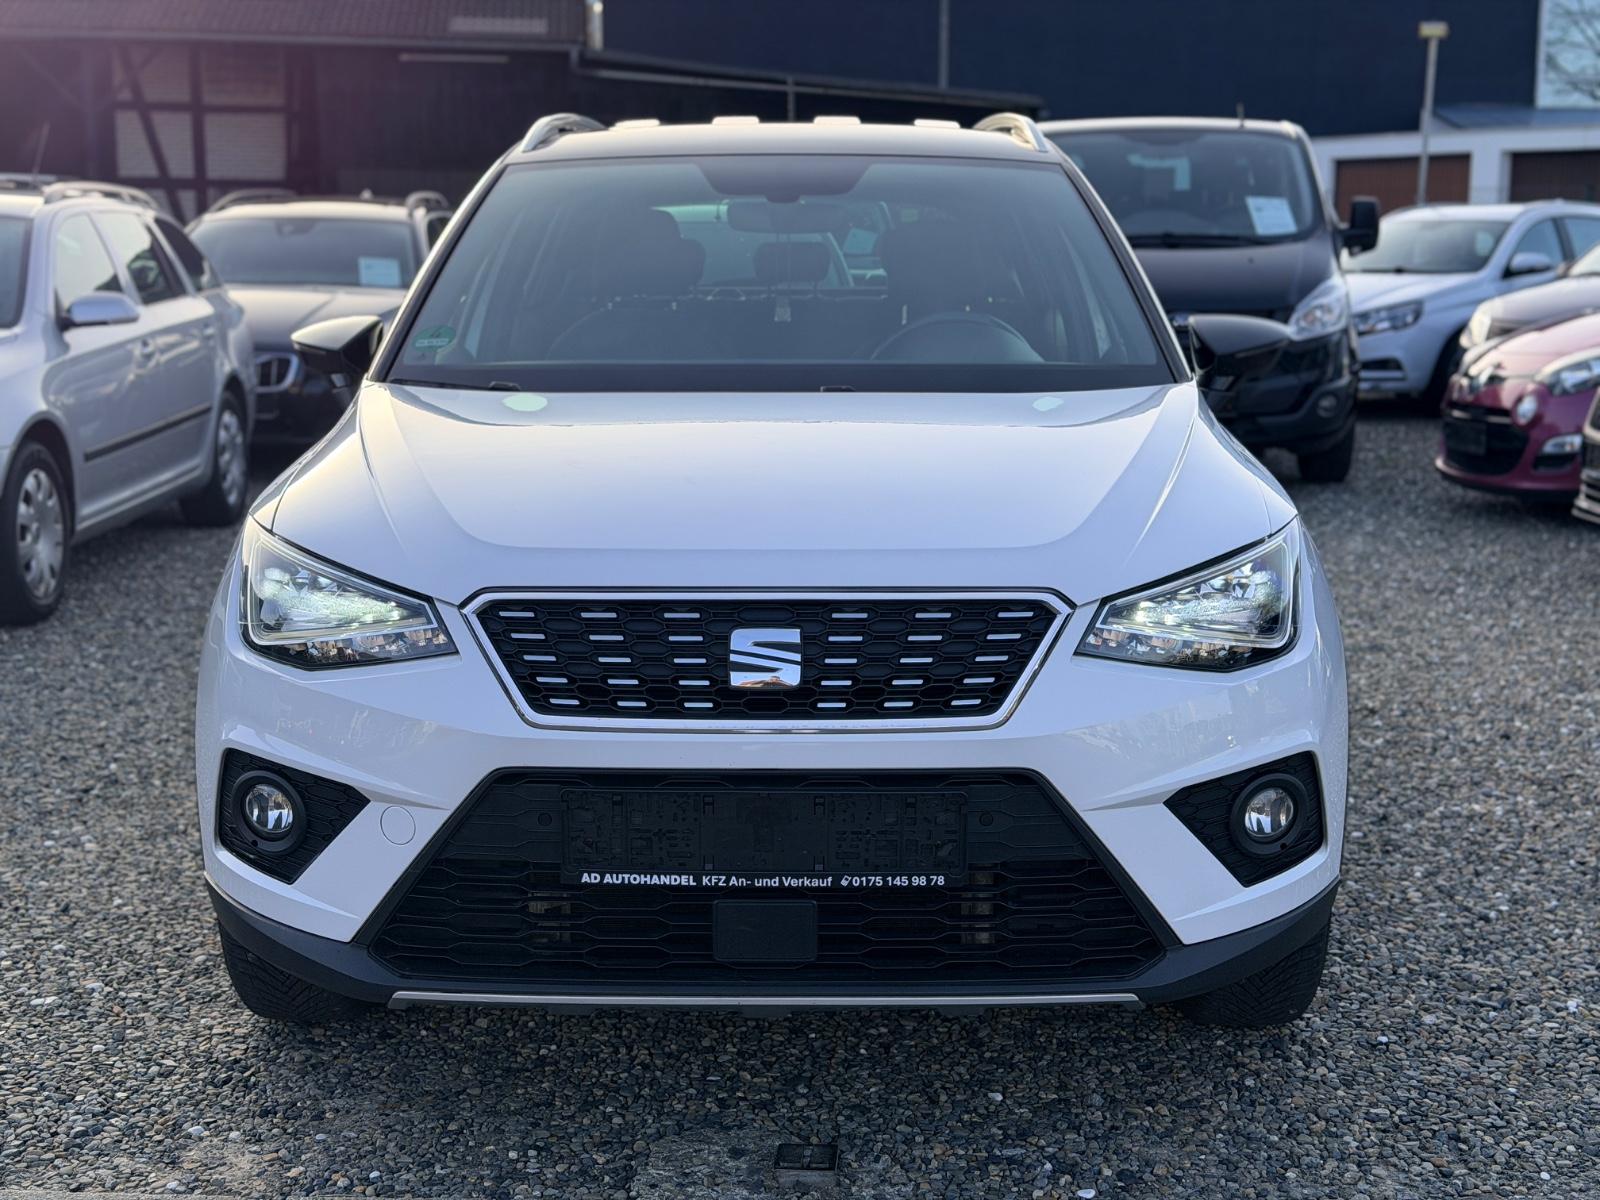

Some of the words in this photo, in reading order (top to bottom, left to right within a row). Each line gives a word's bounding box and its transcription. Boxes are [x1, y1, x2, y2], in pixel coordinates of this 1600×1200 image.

[580, 872, 601, 884] AD
[604, 873, 697, 886] AUTOHANDEL
[702, 875, 727, 886] KFZ
[728, 875, 752, 887] An-
[754, 876, 779, 887] und
[781, 876, 833, 887] Verkauf
[852, 876, 883, 887] 0175
[886, 876, 909, 887] 145
[911, 875, 927, 887] 98
[929, 875, 945, 887] 78
